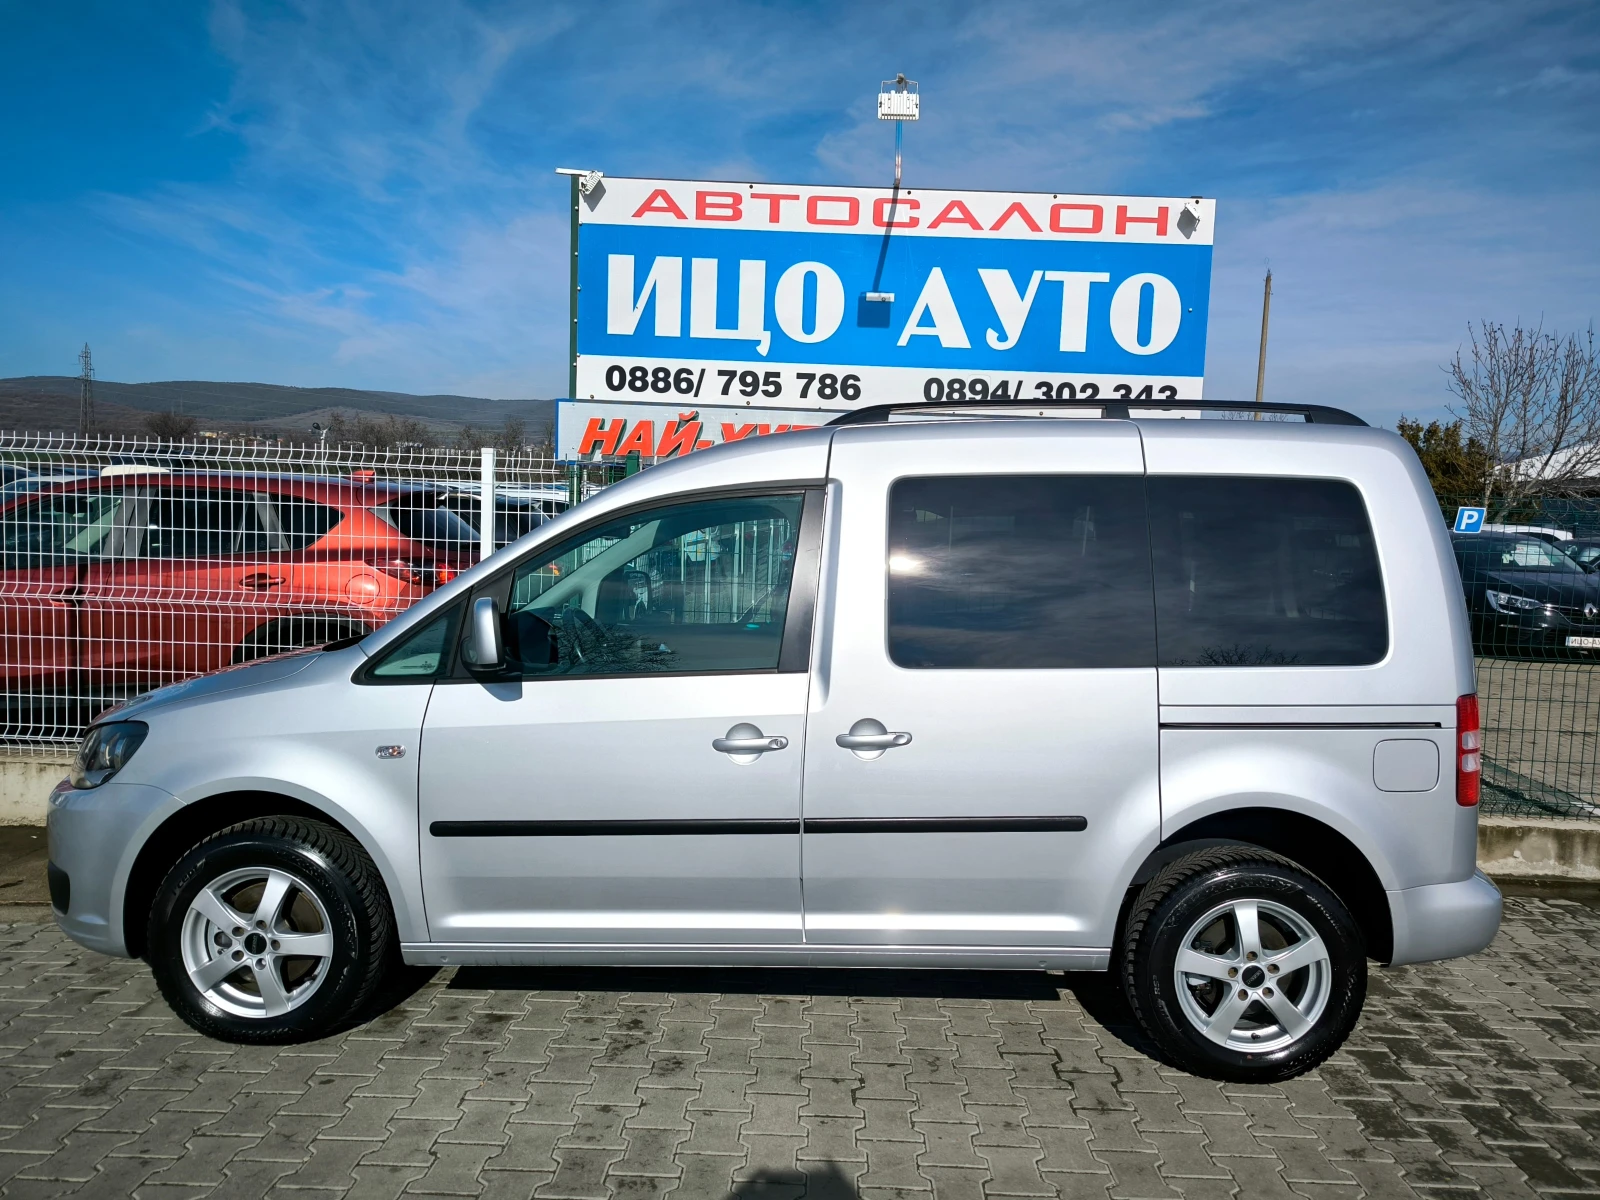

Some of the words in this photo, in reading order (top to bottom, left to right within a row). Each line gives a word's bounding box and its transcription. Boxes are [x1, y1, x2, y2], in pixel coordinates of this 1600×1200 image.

[631, 188, 1169, 237] АВТОСАЛОН
[605, 364, 706, 398] 0886/
[717, 369, 782, 398] 795
[796, 372, 862, 401] 786
[1033, 381, 1100, 401] 302
[1459, 510, 1479, 530] P
